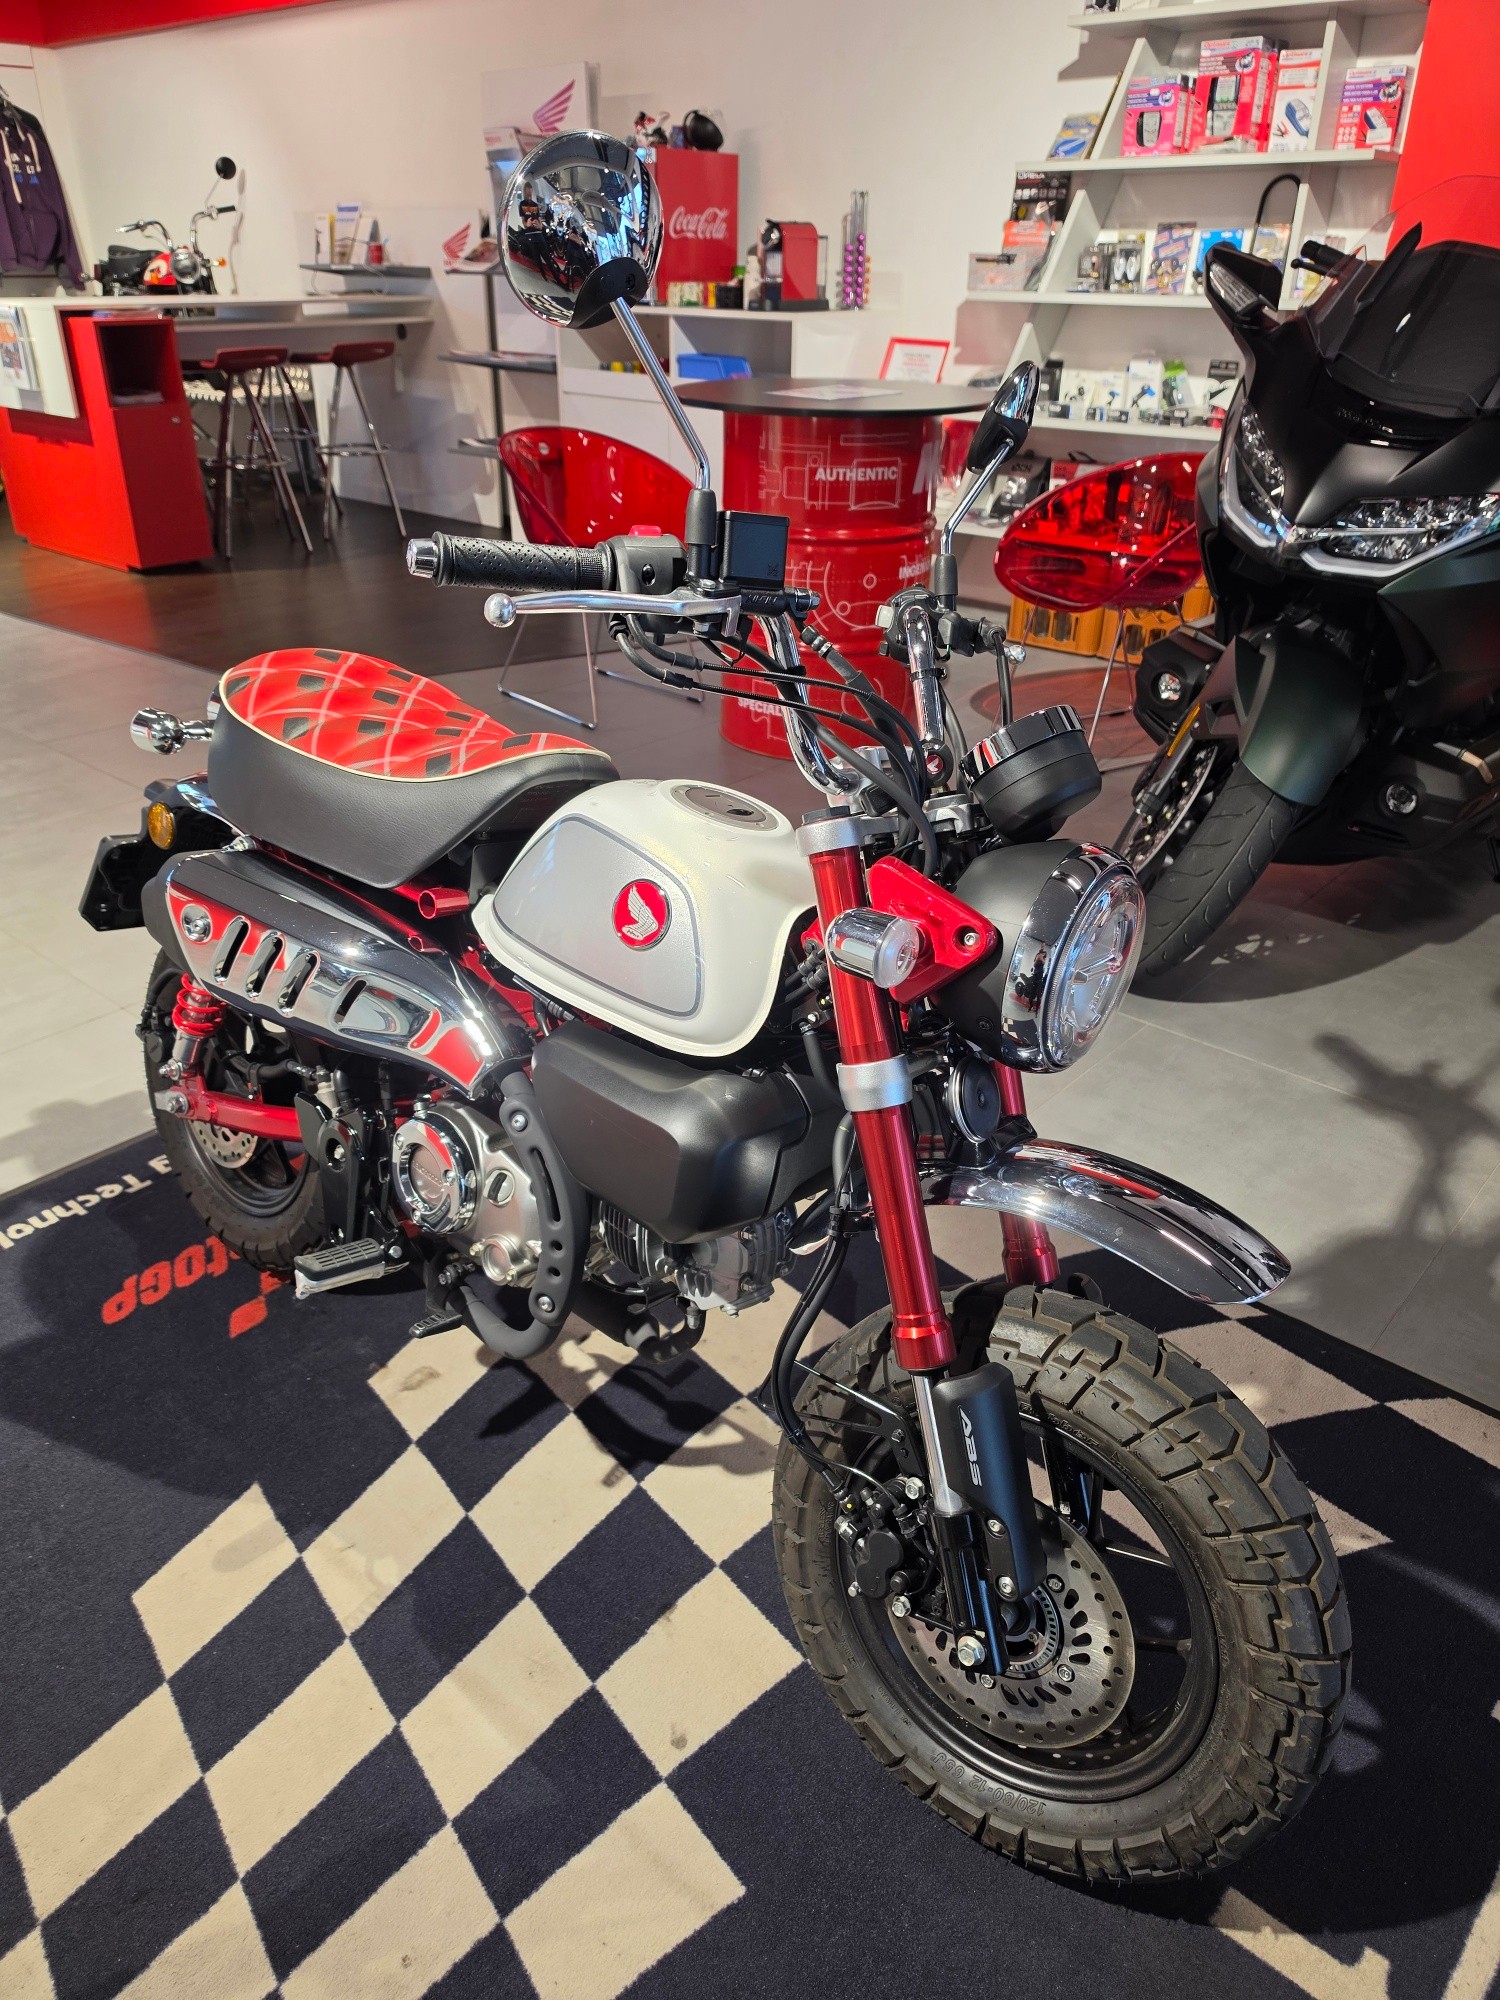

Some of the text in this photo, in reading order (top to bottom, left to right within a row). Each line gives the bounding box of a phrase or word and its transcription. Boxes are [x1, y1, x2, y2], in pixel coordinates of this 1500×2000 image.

[815, 466, 898, 481] AUTHENTIC
[102, 1236, 237, 1325] toGP
[957, 1406, 983, 1487] ABS
[933, 1752, 1047, 1816] 120/80-12 65J
